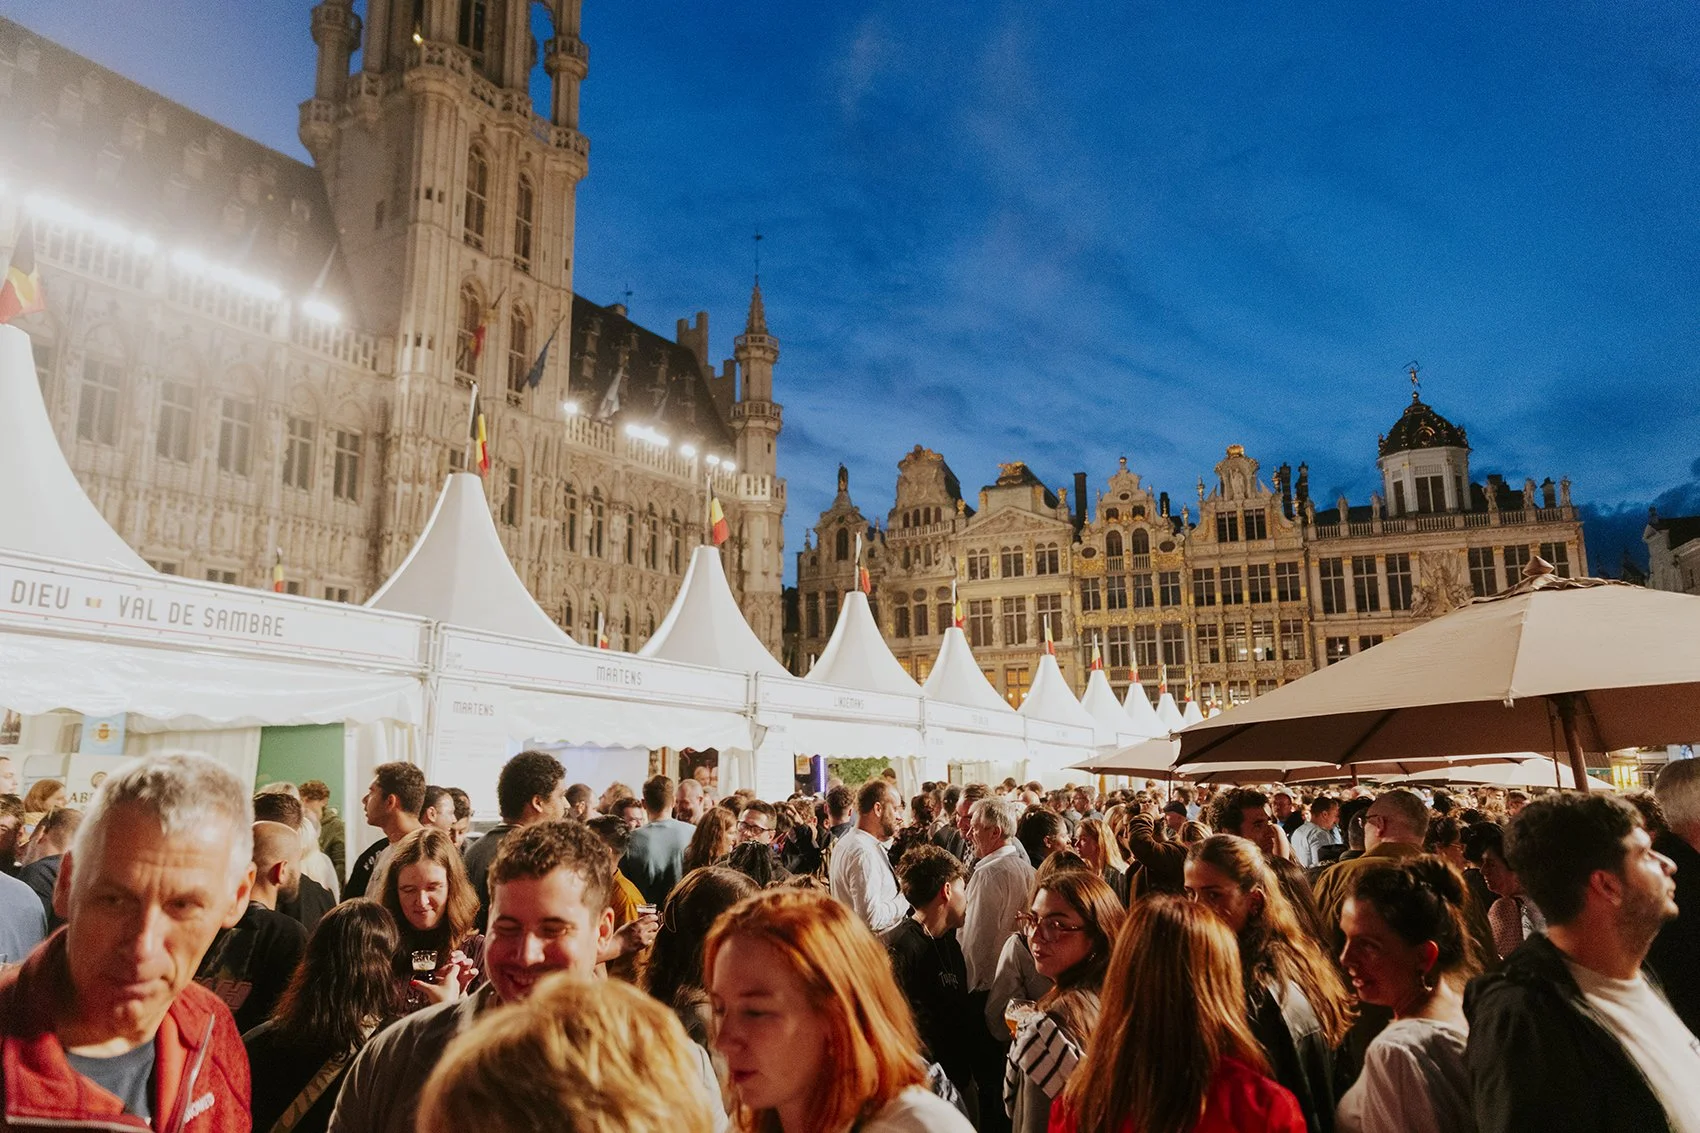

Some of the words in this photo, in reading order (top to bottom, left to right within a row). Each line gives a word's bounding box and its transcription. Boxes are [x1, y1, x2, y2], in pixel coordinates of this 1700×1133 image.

[10, 580, 71, 609] DIEU
[119, 594, 158, 622] VAL
[168, 602, 195, 626] DE
[203, 607, 285, 637] SAMBRE
[596, 665, 642, 686] MARTENS
[452, 700, 495, 717] MARTENS
